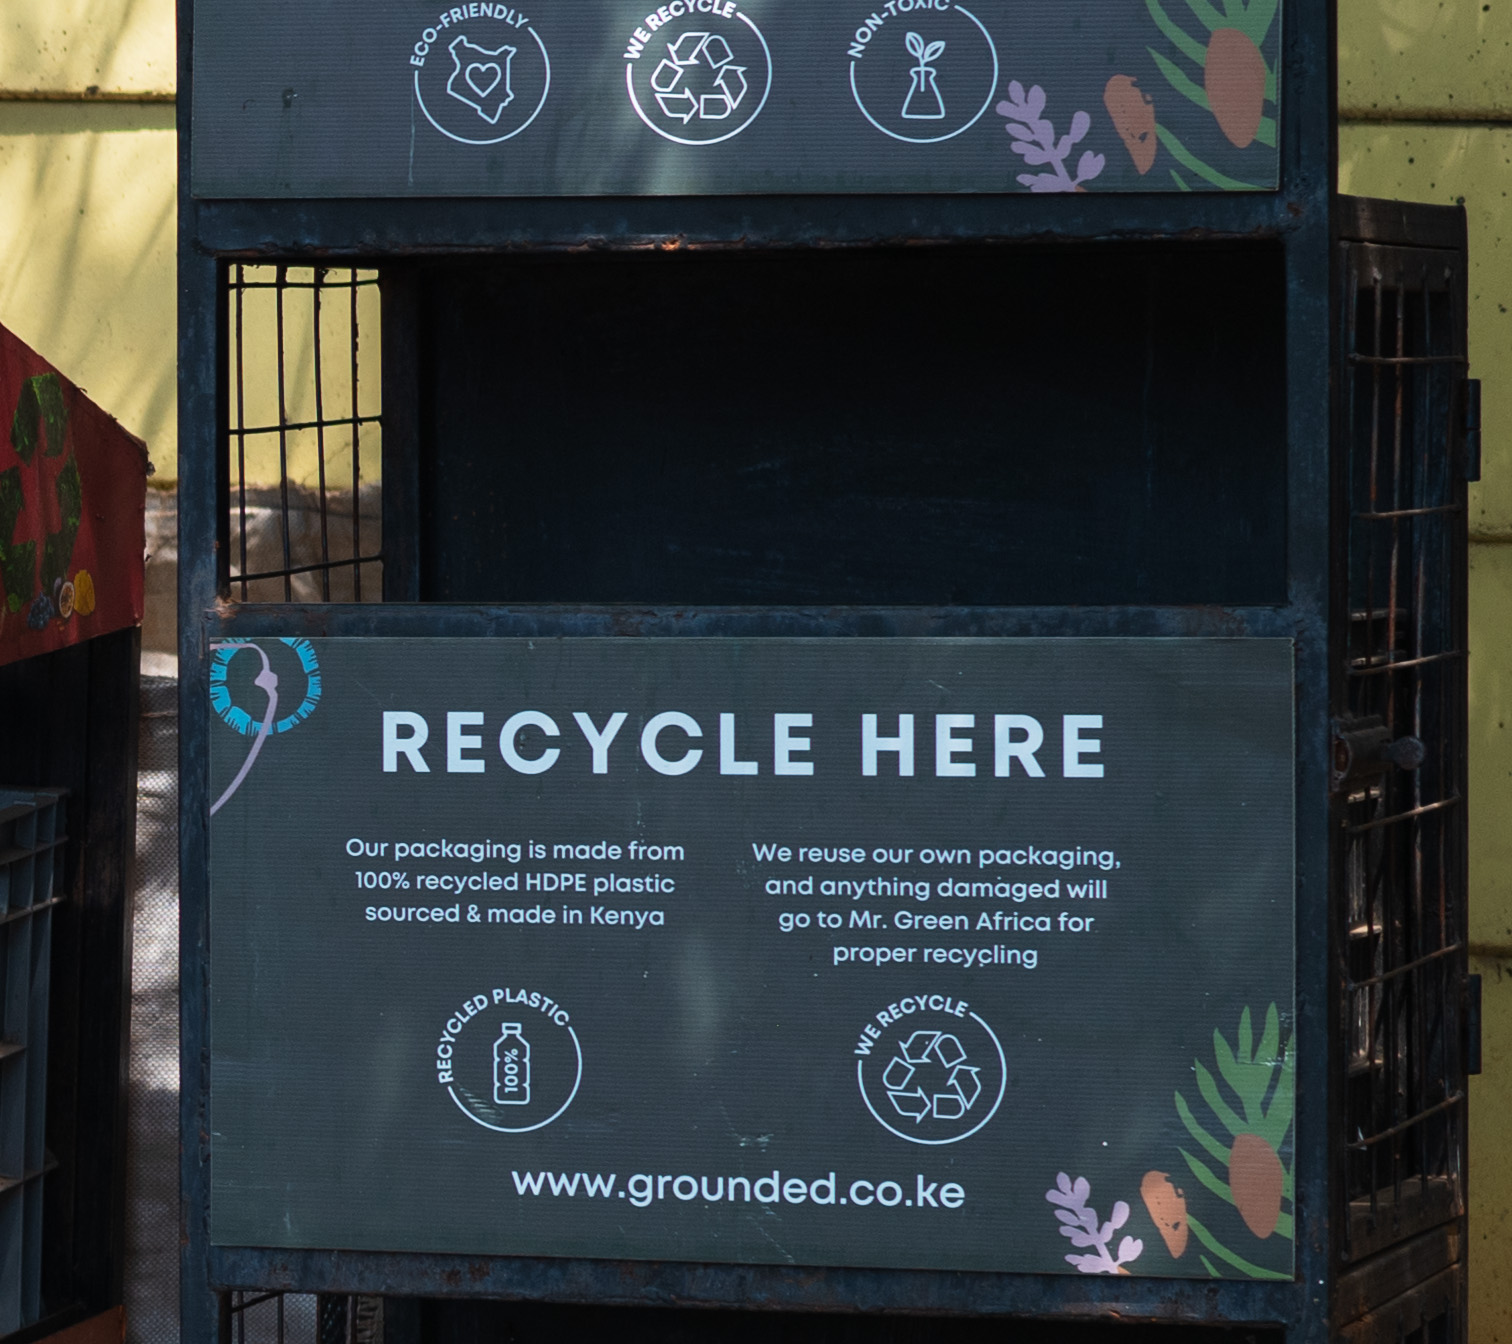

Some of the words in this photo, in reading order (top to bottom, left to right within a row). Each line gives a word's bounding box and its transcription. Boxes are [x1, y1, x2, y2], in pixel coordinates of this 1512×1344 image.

[410, 2, 529, 67] ECO-FRIENDLY
[623, 30, 650, 61] WE
[383, 710, 813, 775] RECYCLE
[862, 713, 1104, 777] HERE
[346, 838, 388, 856] Our
[395, 838, 521, 863] packaging
[529, 840, 546, 858] is
[553, 840, 622, 859] made
[628, 840, 684, 860] from
[752, 843, 791, 861] We
[799, 847, 866, 862] reuse
[872, 848, 913, 863] our
[919, 848, 970, 863] own
[979, 845, 1120, 870] packaging,
[355, 871, 410, 889] 100%
[416, 871, 518, 894] recycled
[526, 872, 586, 891] HDPE
[594, 873, 674, 896] plastic
[765, 876, 812, 894] and
[820, 876, 929, 901] anything
[937, 878, 1059, 902] damaged
[1066, 879, 1106, 898] will
[365, 903, 459, 922] sourced
[466, 904, 481, 922] &
[488, 904, 556, 923] made
[563, 905, 582, 924] in
[590, 906, 664, 929] Kenya
[778, 912, 810, 932] go
[816, 911, 842, 928] to
[849, 910, 886, 928] Mr.
[894, 910, 968, 929] Green
[975, 911, 1050, 931] Africa
[1057, 911, 1094, 931] for
[833, 946, 917, 966] proper
[923, 944, 1037, 969] recycling
[436, 993, 489, 1085] RECYCLED
[492, 987, 571, 1027] PLASTIC
[854, 1023, 882, 1057] WE
[876, 994, 969, 1029] RECYCLE
[504, 1047, 520, 1094] 100%
[511, 1170, 964, 1208] www.grounded.co.ke
